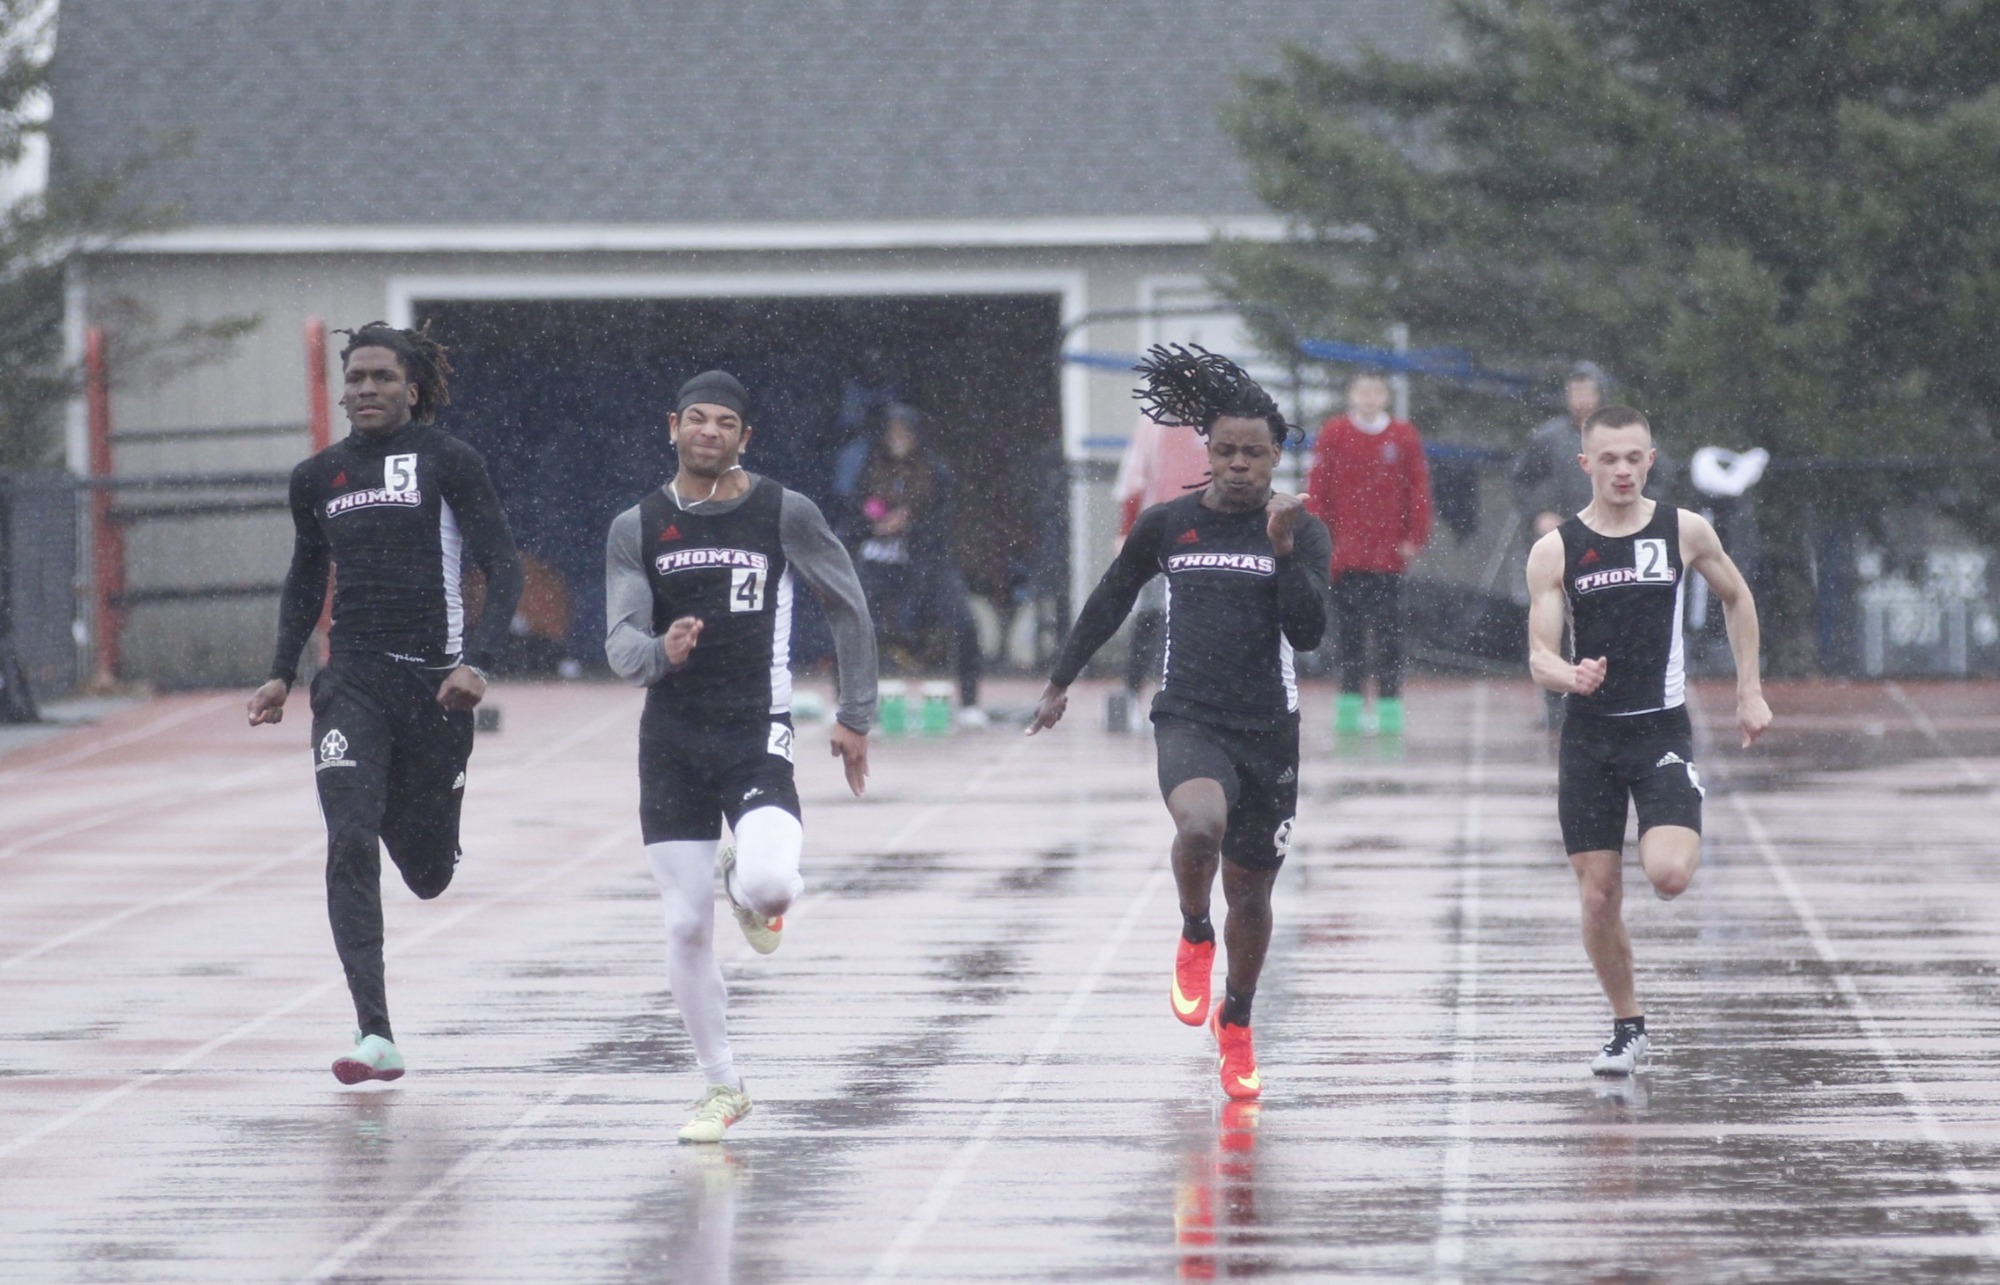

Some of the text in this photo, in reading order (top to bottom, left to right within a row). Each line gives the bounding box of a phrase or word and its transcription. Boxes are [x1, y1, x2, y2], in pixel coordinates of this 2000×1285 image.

[393, 457, 410, 492] 5
[327, 489, 420, 516] THOMAS
[657, 549, 767, 573] THOMAS
[1169, 554, 1275, 574] THOMAS
[1642, 542, 1663, 578] 2
[736, 572, 758, 609] 4
[1576, 568, 1675, 592] THOMS
